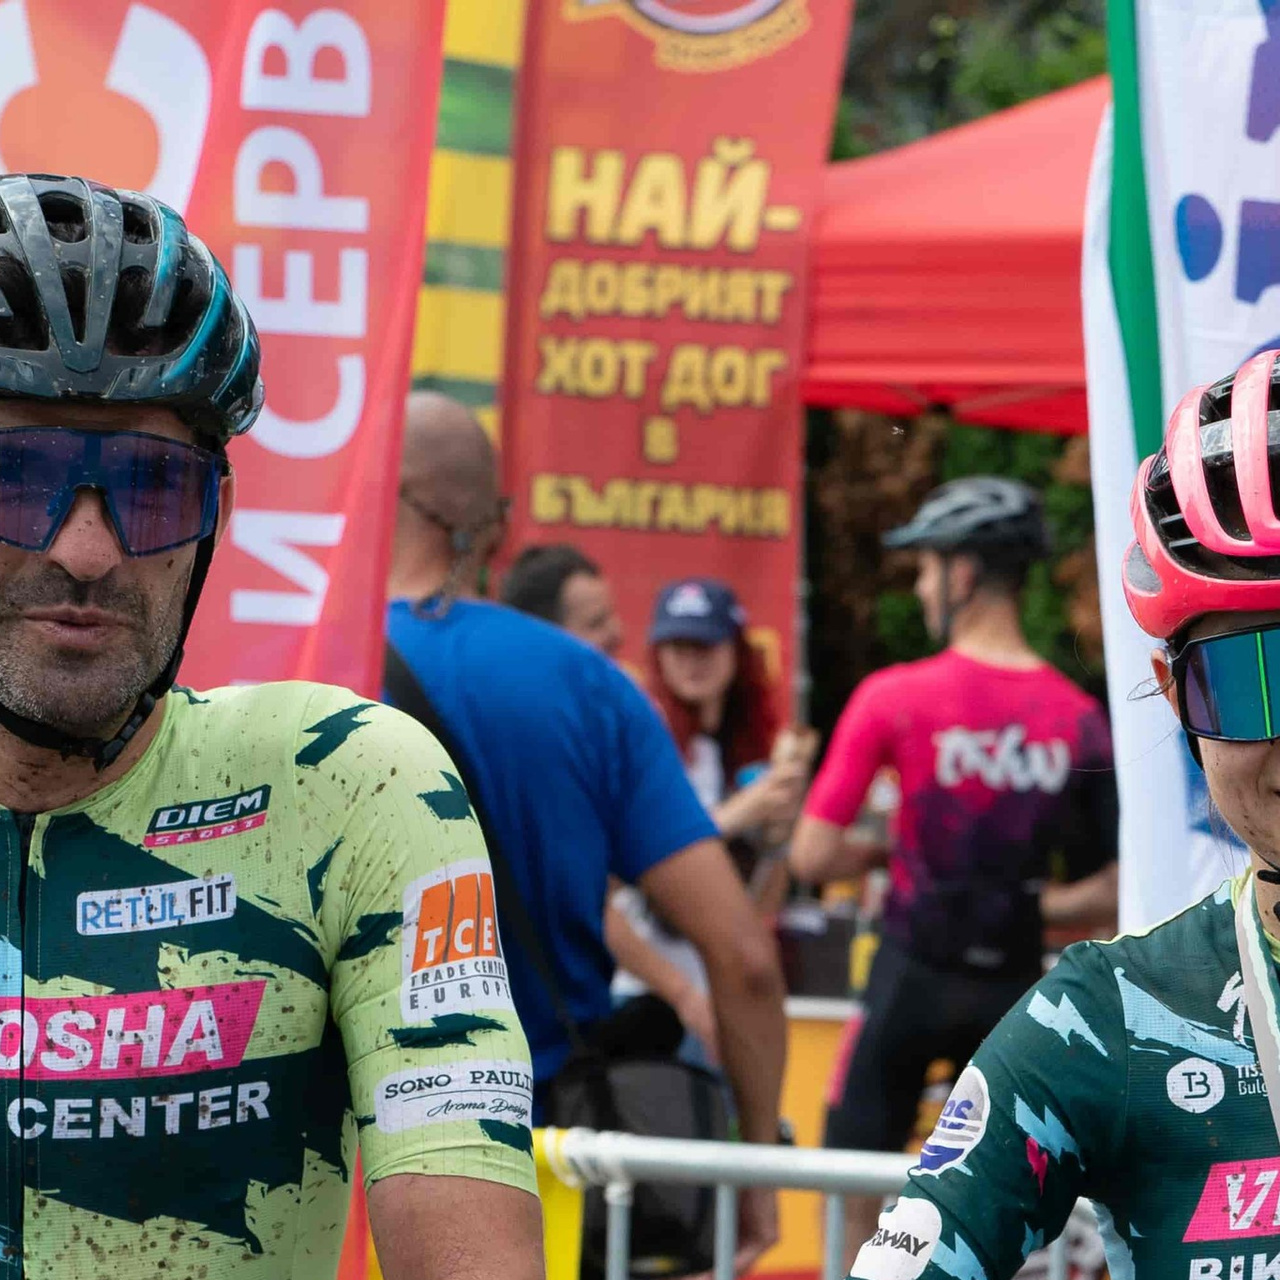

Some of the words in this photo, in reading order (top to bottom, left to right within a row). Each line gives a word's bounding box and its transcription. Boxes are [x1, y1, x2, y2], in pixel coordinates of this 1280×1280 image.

[546, 135, 801, 253] НАЙ-
[540, 258, 792, 325] ДОБРИЯТ
[536, 335, 657, 399] ХОТ
[661, 343, 788, 415] ДОГ
[530, 472, 791, 540] БЪЛГАРИЯ
[155, 790, 264, 828] DIEM
[155, 819, 254, 846] SPORT
[423, 917, 493, 963] TCE
[411, 963, 467, 988] TRADE
[7, 1080, 272, 1140] CENTER
[384, 1074, 453, 1100] SONO
[426, 1099, 487, 1117] Aroma
